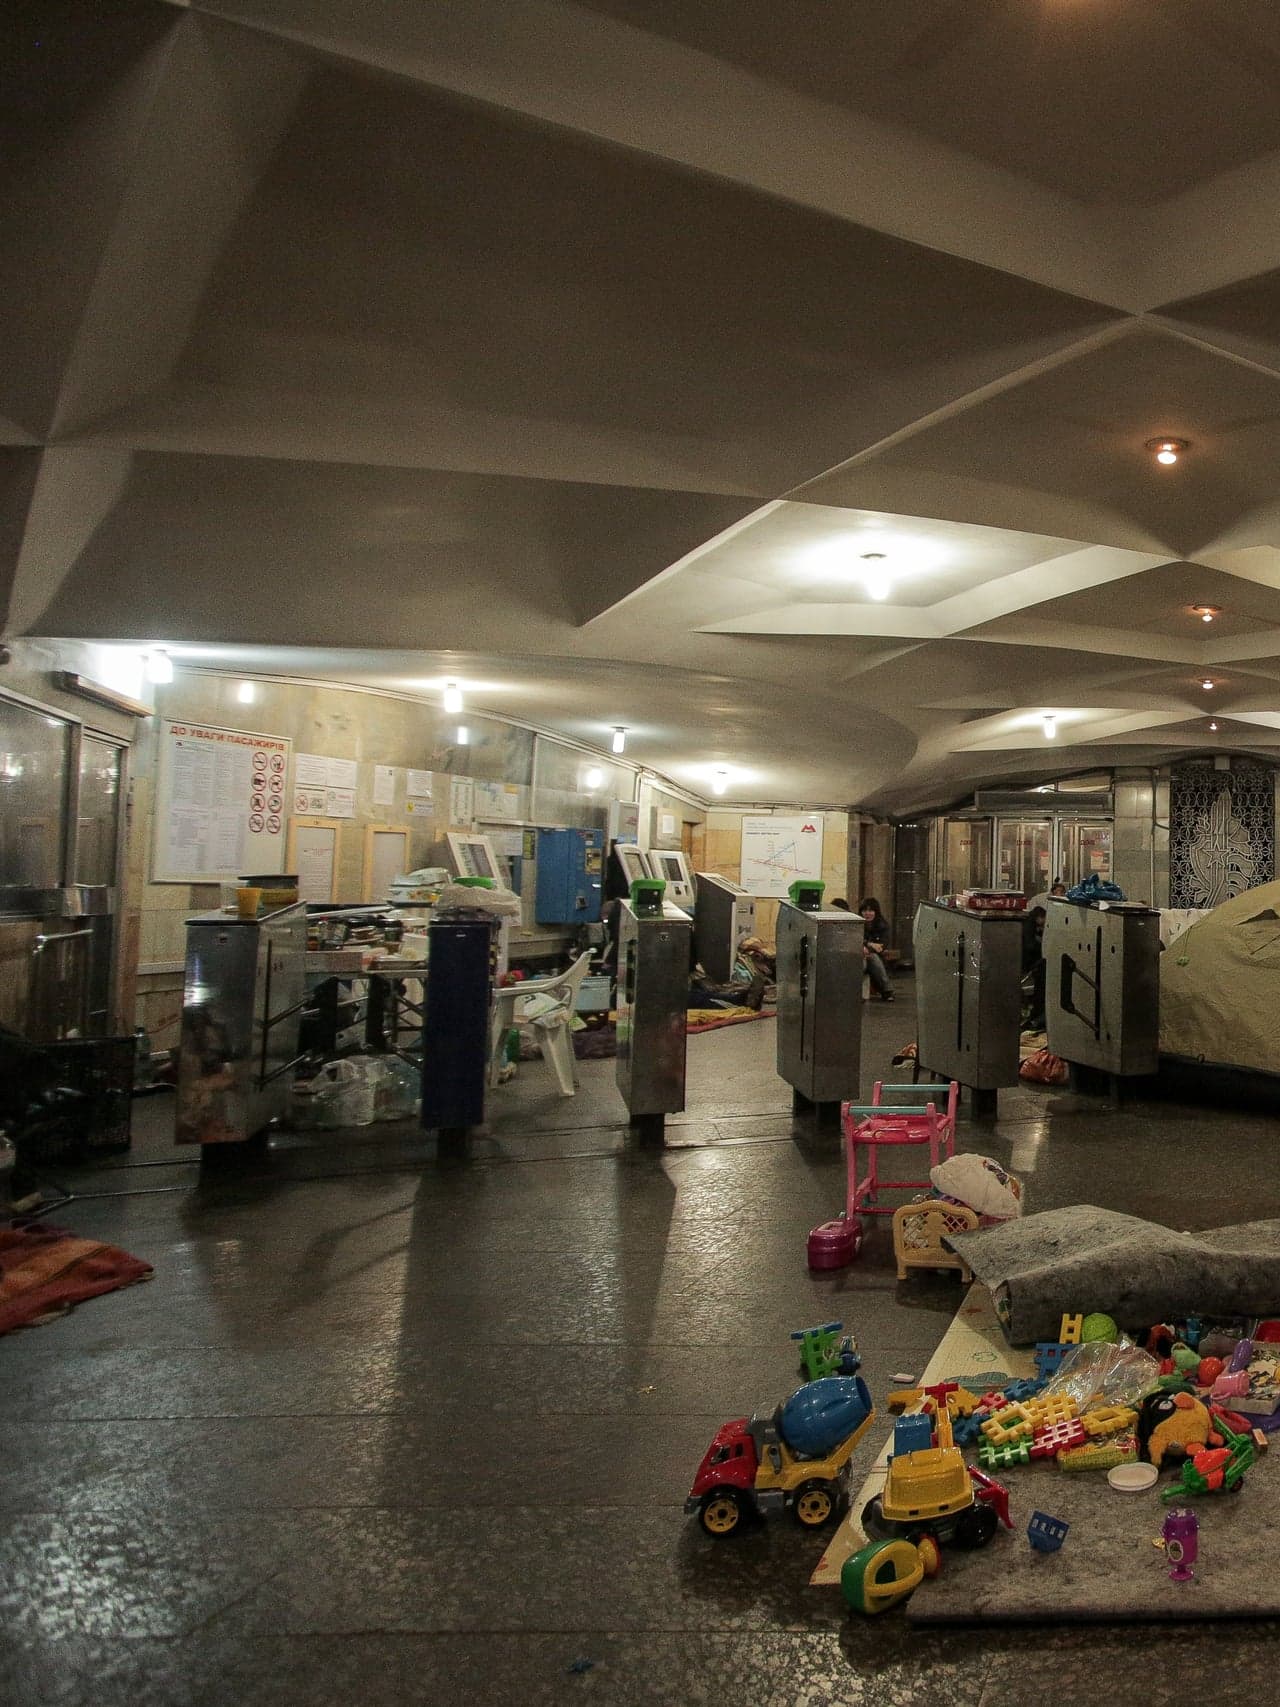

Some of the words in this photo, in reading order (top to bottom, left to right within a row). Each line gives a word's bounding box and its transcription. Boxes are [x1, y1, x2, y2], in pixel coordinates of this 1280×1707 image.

[170, 726, 186, 736] ДО
[189, 728, 225, 741] УВАГИ
[226, 735, 285, 751] ПАСАЖИРІВ
